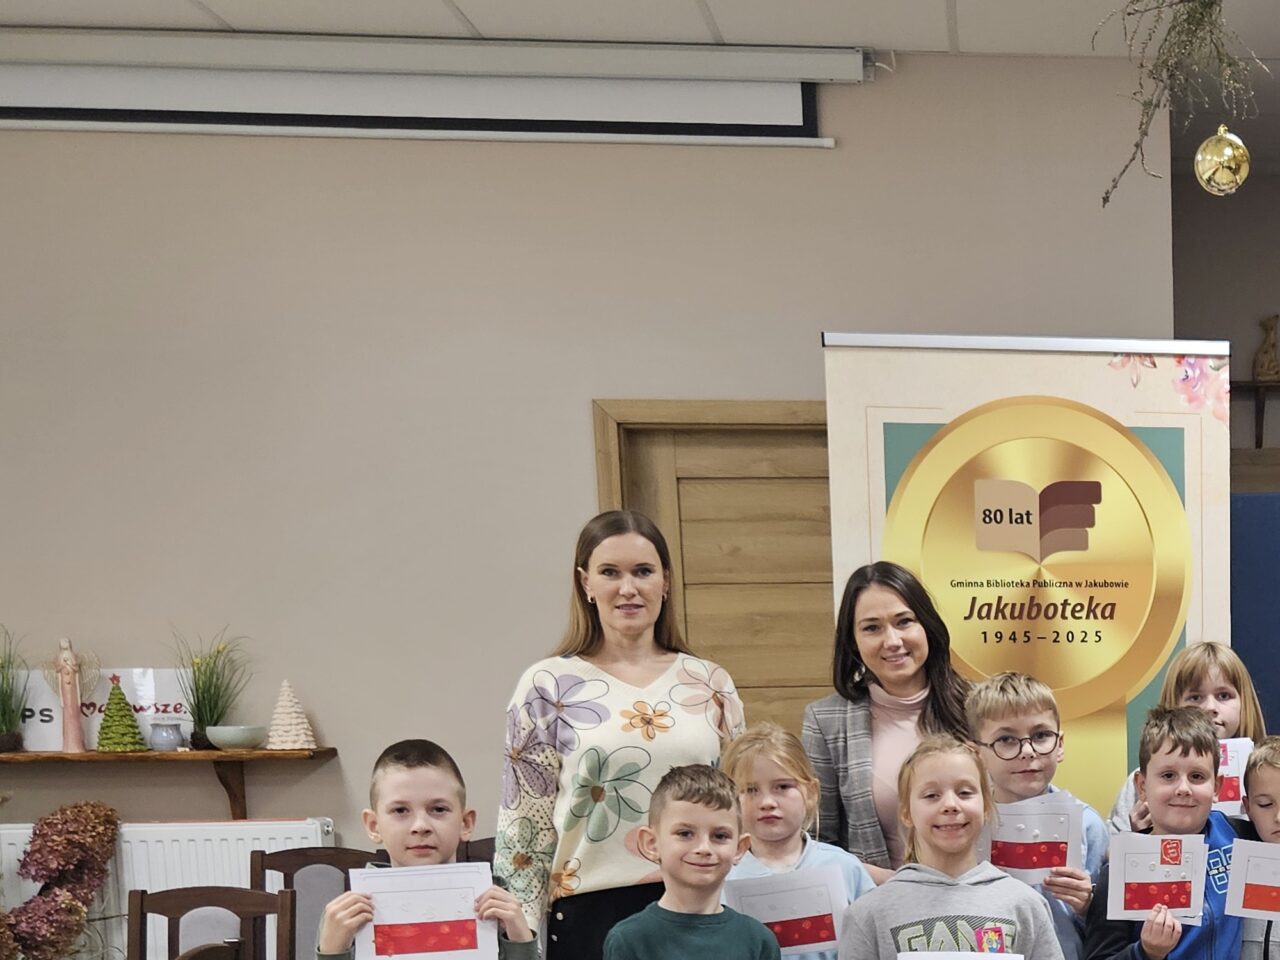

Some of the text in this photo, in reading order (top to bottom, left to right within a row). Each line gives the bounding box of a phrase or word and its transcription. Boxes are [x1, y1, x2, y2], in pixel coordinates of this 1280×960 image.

[982, 508, 1033, 525] 80 lat
[950, 579, 984, 588] Gminna
[986, 579, 1031, 588] Biblioteka
[1032, 579, 1073, 588] Publiczna
[1084, 579, 1129, 588] Jakubowie
[963, 595, 1117, 621] Jakuboteka
